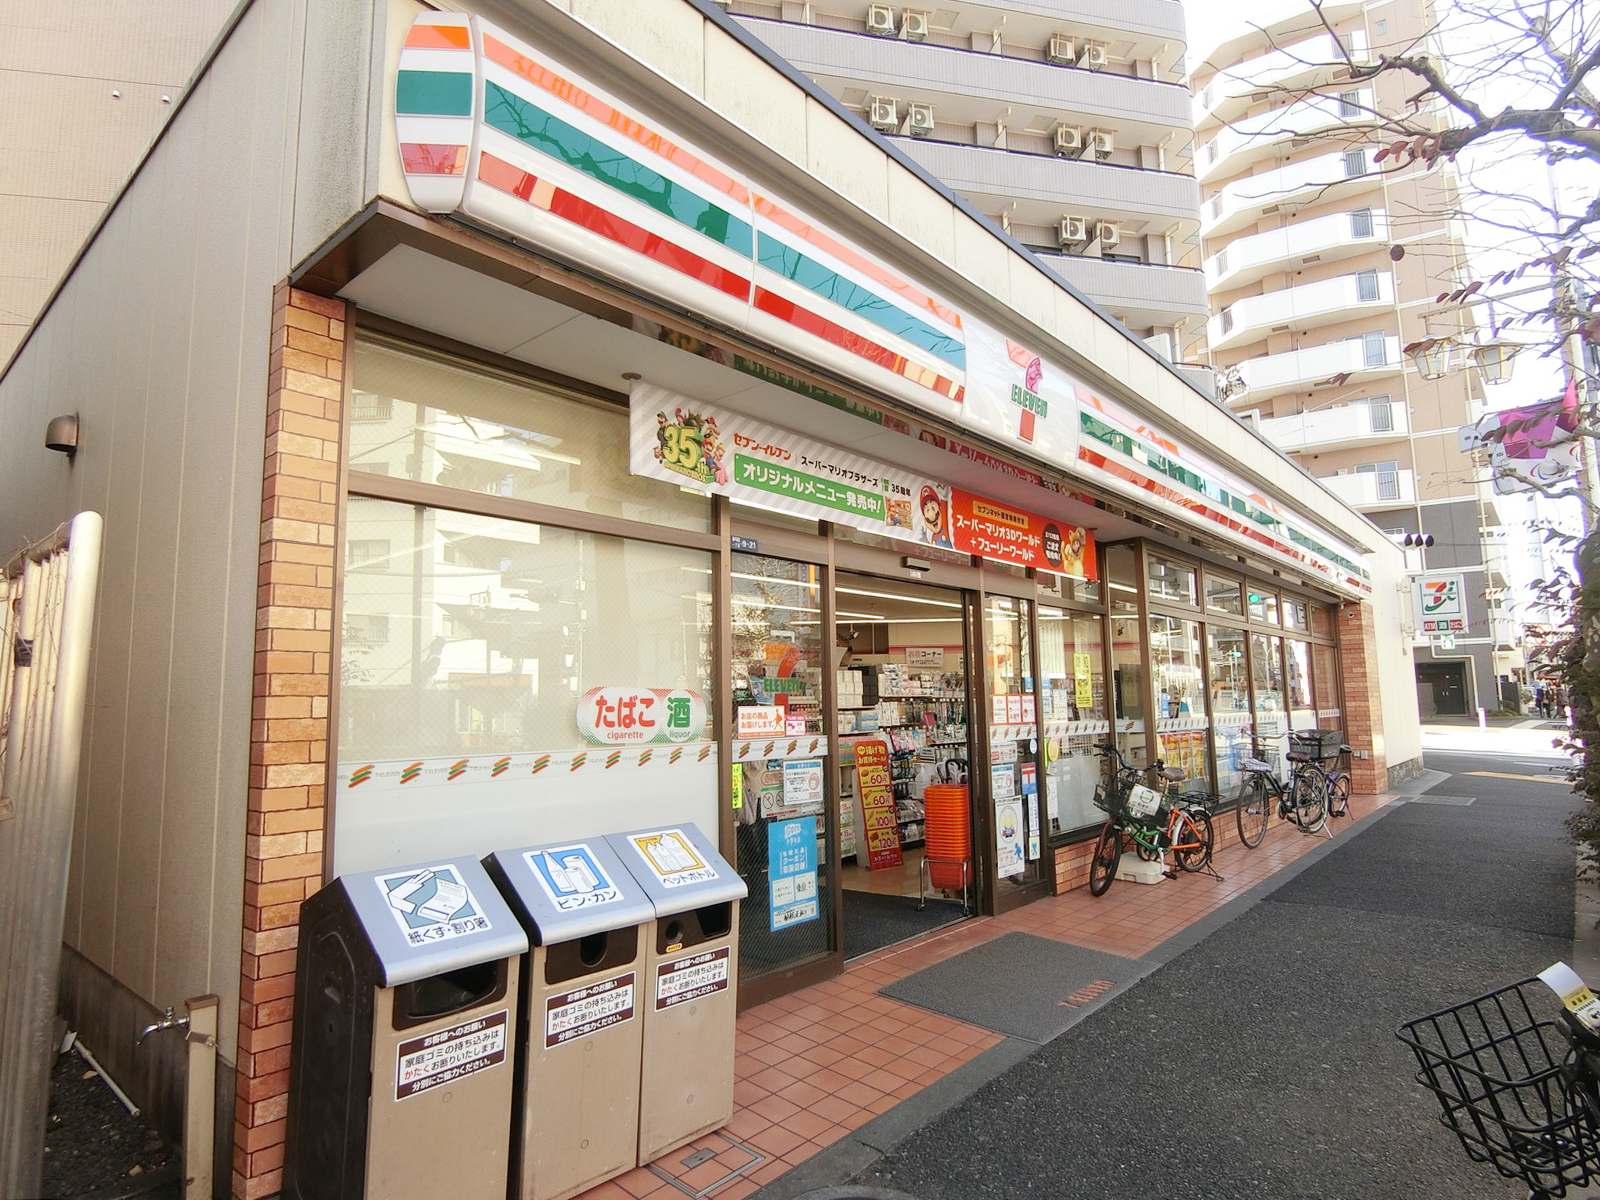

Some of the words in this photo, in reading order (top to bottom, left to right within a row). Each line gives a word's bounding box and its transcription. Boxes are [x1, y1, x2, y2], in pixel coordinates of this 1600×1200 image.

[664, 424, 700, 470] 35
[801, 455, 879, 487] スーパーマリオブラザーズ
[956, 514, 1041, 548] スーパーマリオ3Dワールド
[595, 695, 656, 728] たばこ
[667, 697, 691, 728] 酒
[607, 730, 644, 741] cigarette
[669, 730, 691, 740] liquor
[662, 870, 715, 885] ペットボトル
[557, 890, 617, 910] ビン・カン
[408, 916, 488, 945] 紙くず・割り箸
